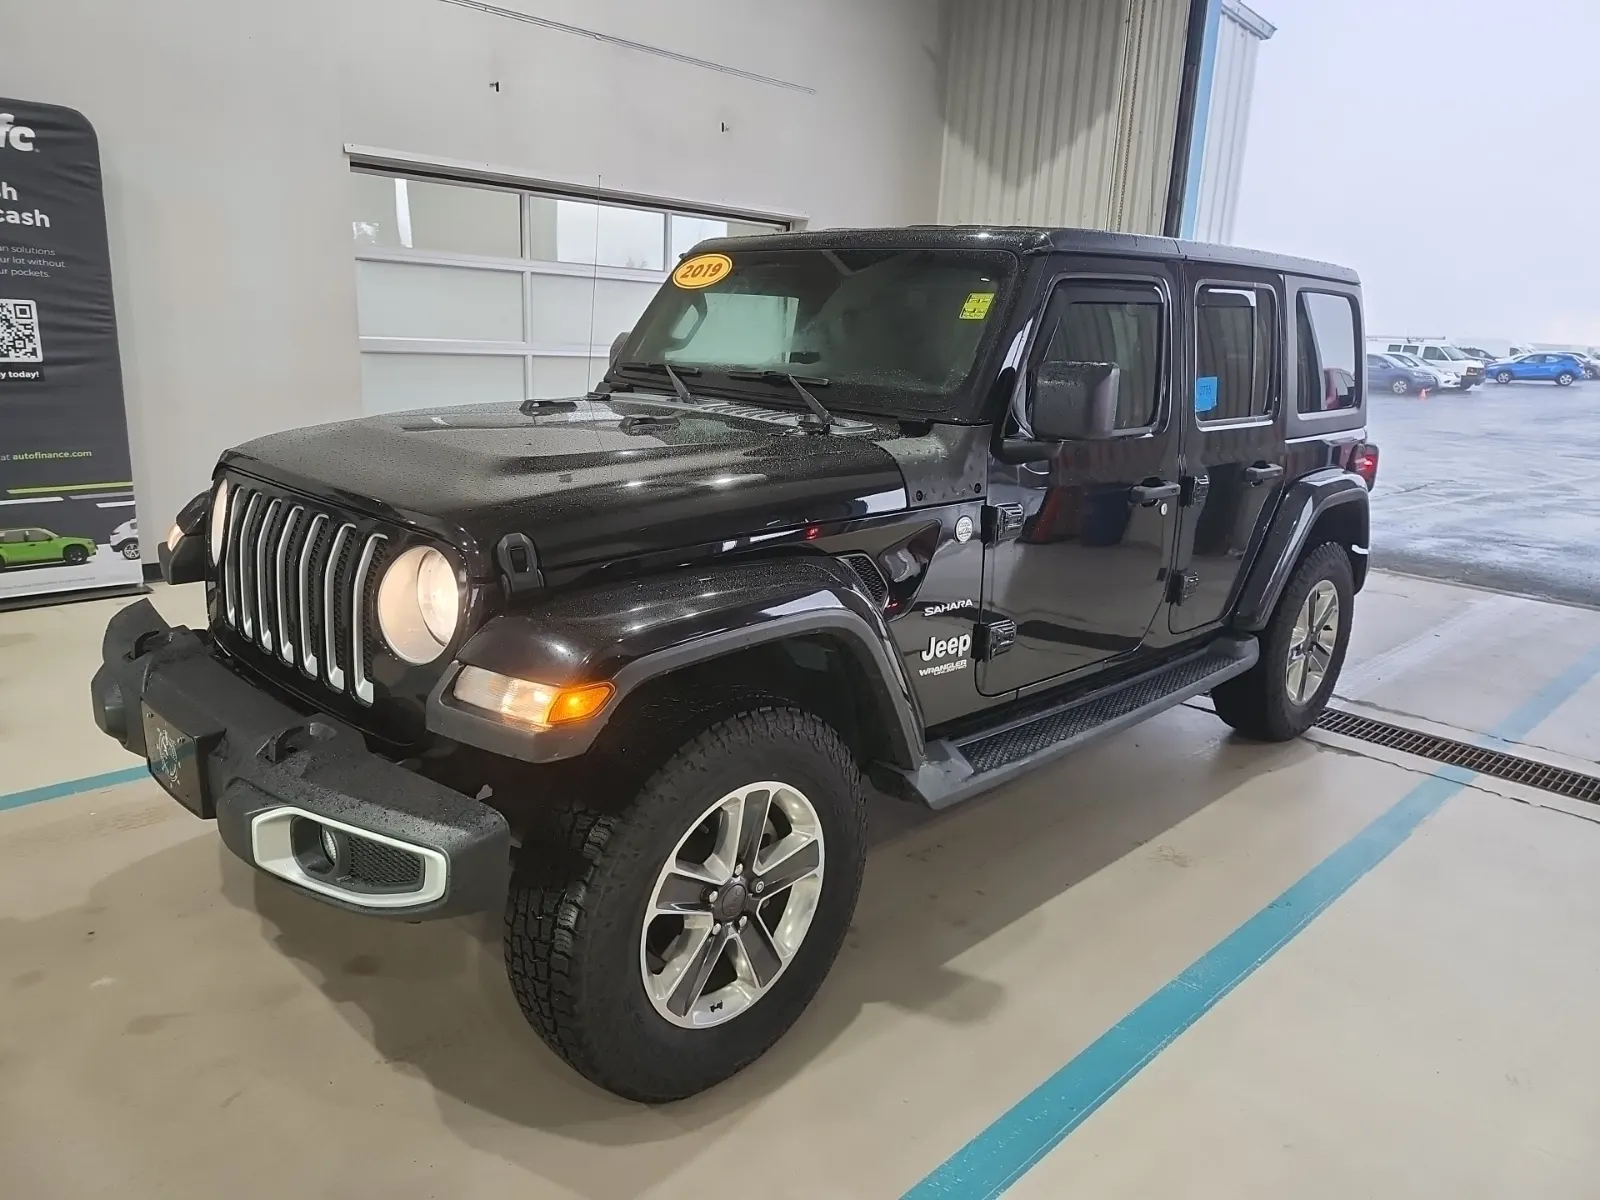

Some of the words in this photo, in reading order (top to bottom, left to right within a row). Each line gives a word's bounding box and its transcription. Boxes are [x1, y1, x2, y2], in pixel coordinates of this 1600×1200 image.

[11, 246, 56, 256] solutions
[12, 256, 26, 265] lot
[27, 258, 66, 268] without
[11, 268, 51, 278] pockets.
[680, 263, 723, 278] 2019
[8, 370, 40, 380] today!
[12, 450, 93, 461] autofinance.com
[924, 599, 973, 616] SAHARA
[921, 633, 971, 662] Jeep
[919, 659, 967, 676] WRANGLER
